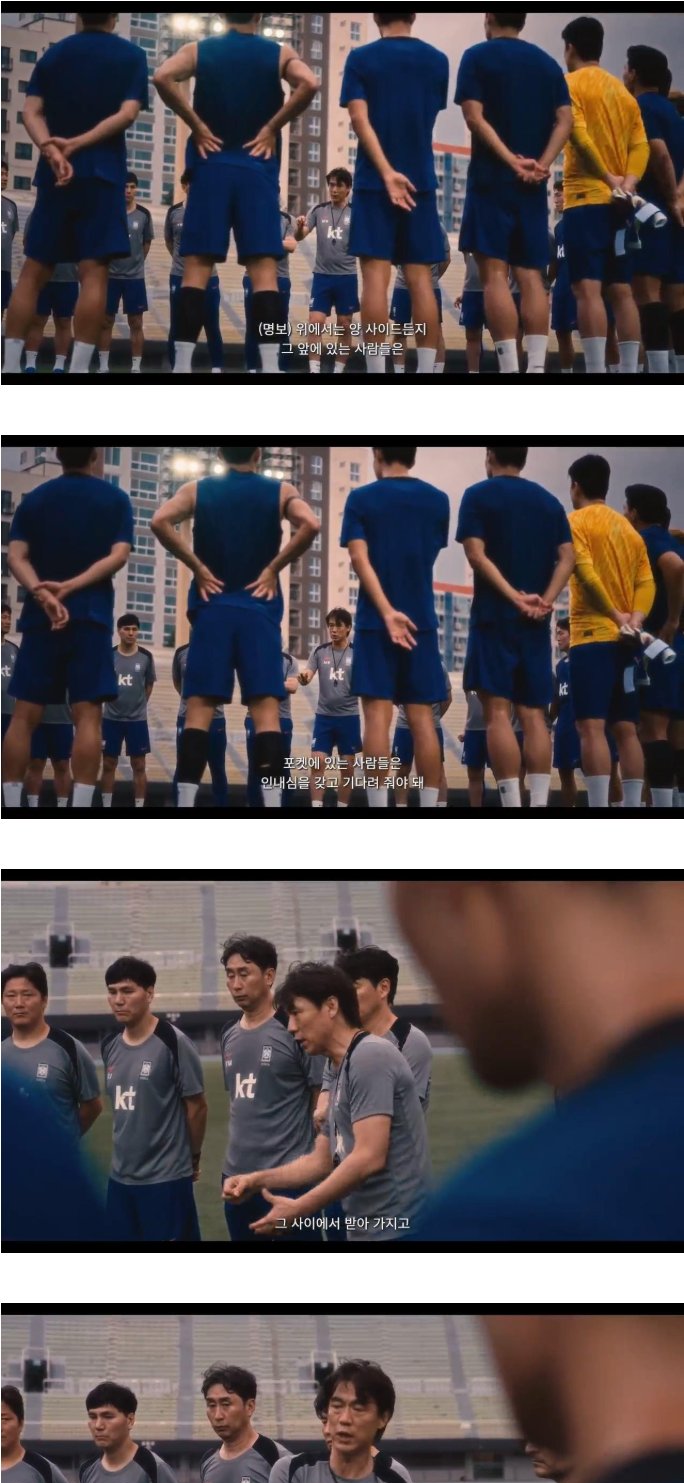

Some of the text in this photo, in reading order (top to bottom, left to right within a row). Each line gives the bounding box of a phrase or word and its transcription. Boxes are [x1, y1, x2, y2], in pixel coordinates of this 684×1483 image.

[327, 226, 343, 239] kt
[118, 673, 133, 686] kt
[329, 667, 345, 681] kt
[235, 1072, 257, 1099] kt
[115, 1085, 136, 1110] kt
